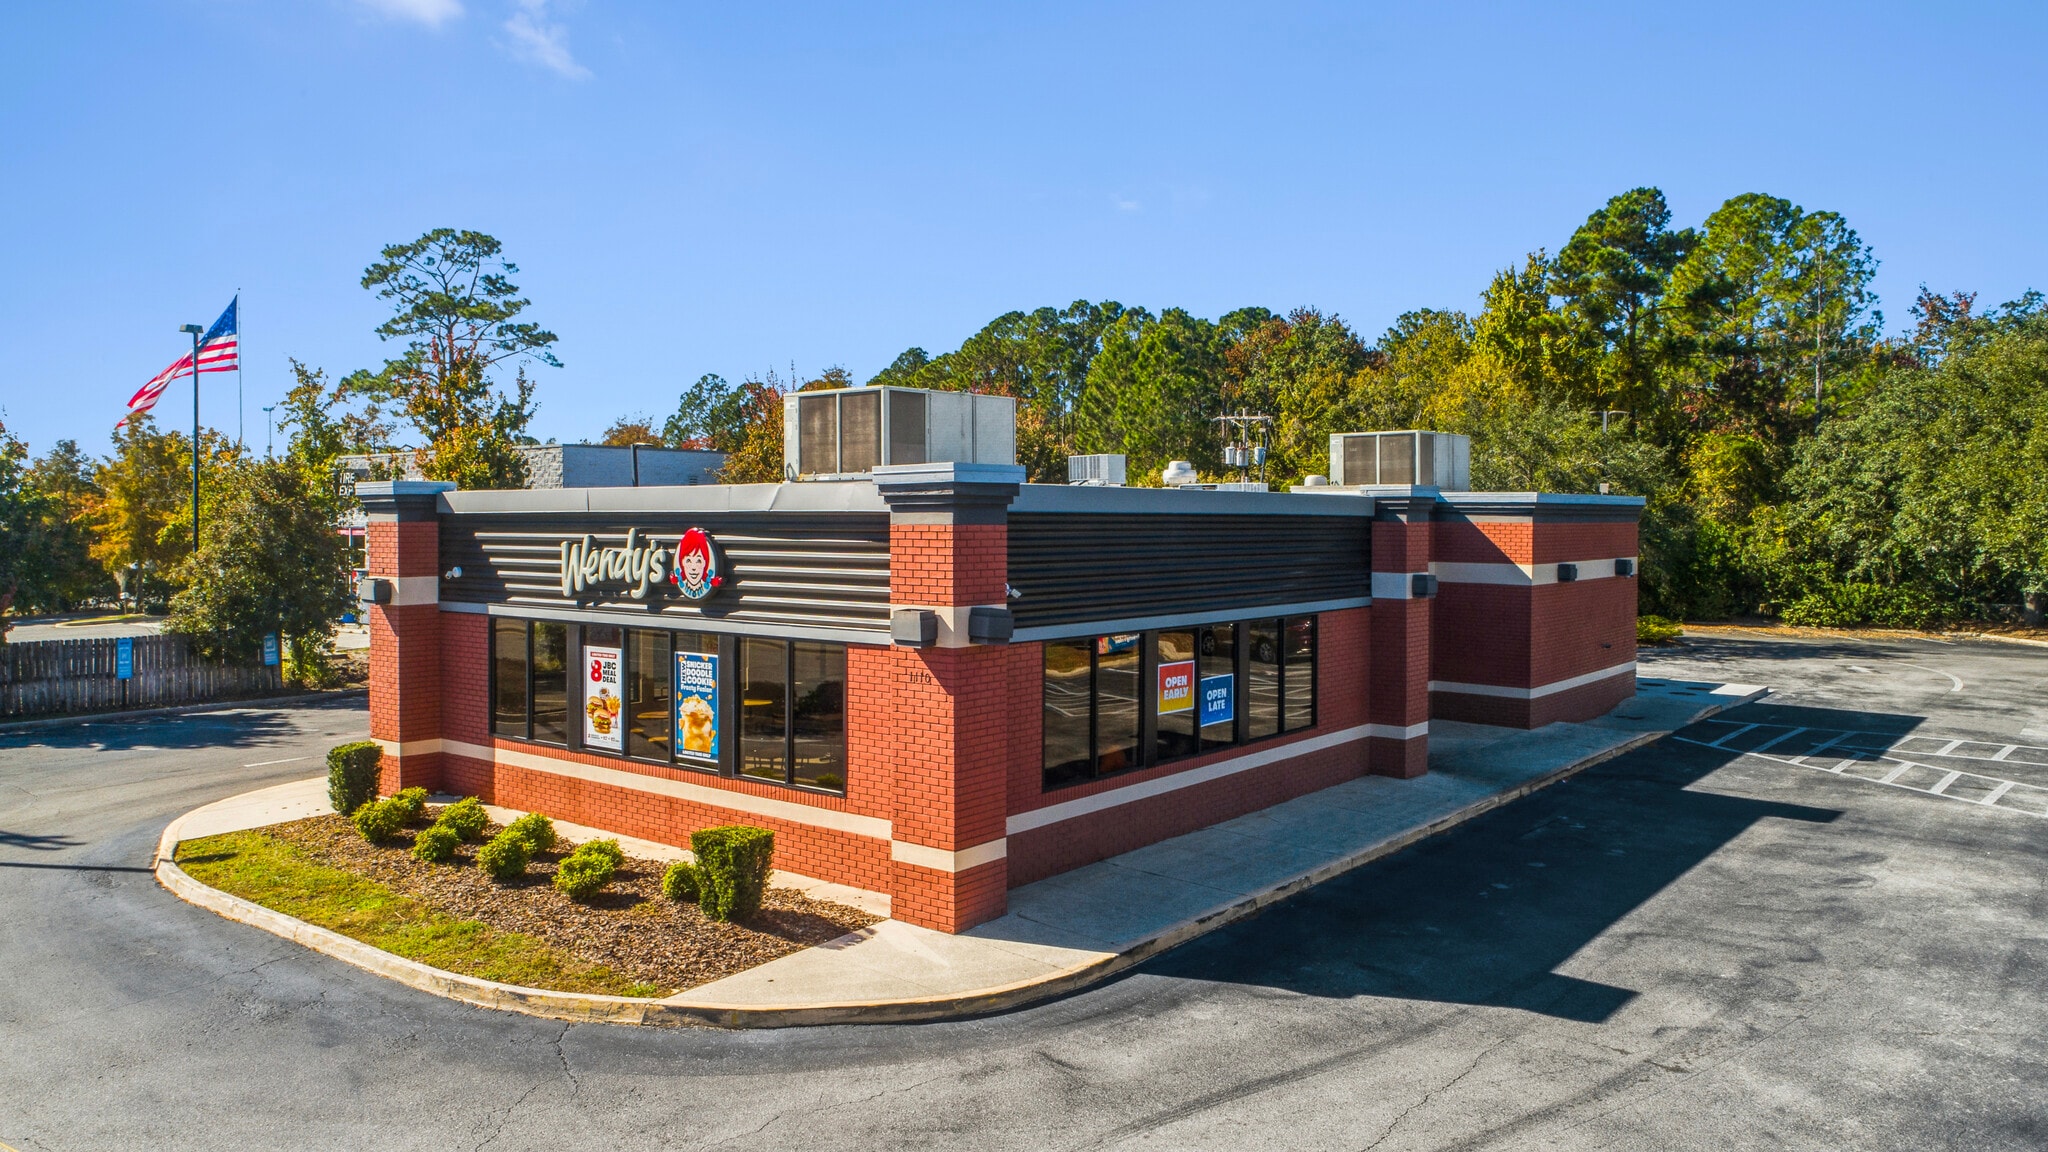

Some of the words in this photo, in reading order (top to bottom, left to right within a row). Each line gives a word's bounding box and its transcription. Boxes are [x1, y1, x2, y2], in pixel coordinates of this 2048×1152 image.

[560, 527, 666, 600] Wendy's
[603, 661, 616, 670] JBC
[686, 660, 712, 670] SNICKER
[603, 669, 616, 677] MEAL
[686, 668, 712, 678] DOODLE
[603, 676, 616, 684] DEAL
[686, 676, 712, 686] COOKIE
[1165, 675, 1188, 687] OPEN
[1164, 687, 1188, 700] EARLY
[1206, 688, 1227, 701] OPEN
[1208, 699, 1226, 712] LATE
